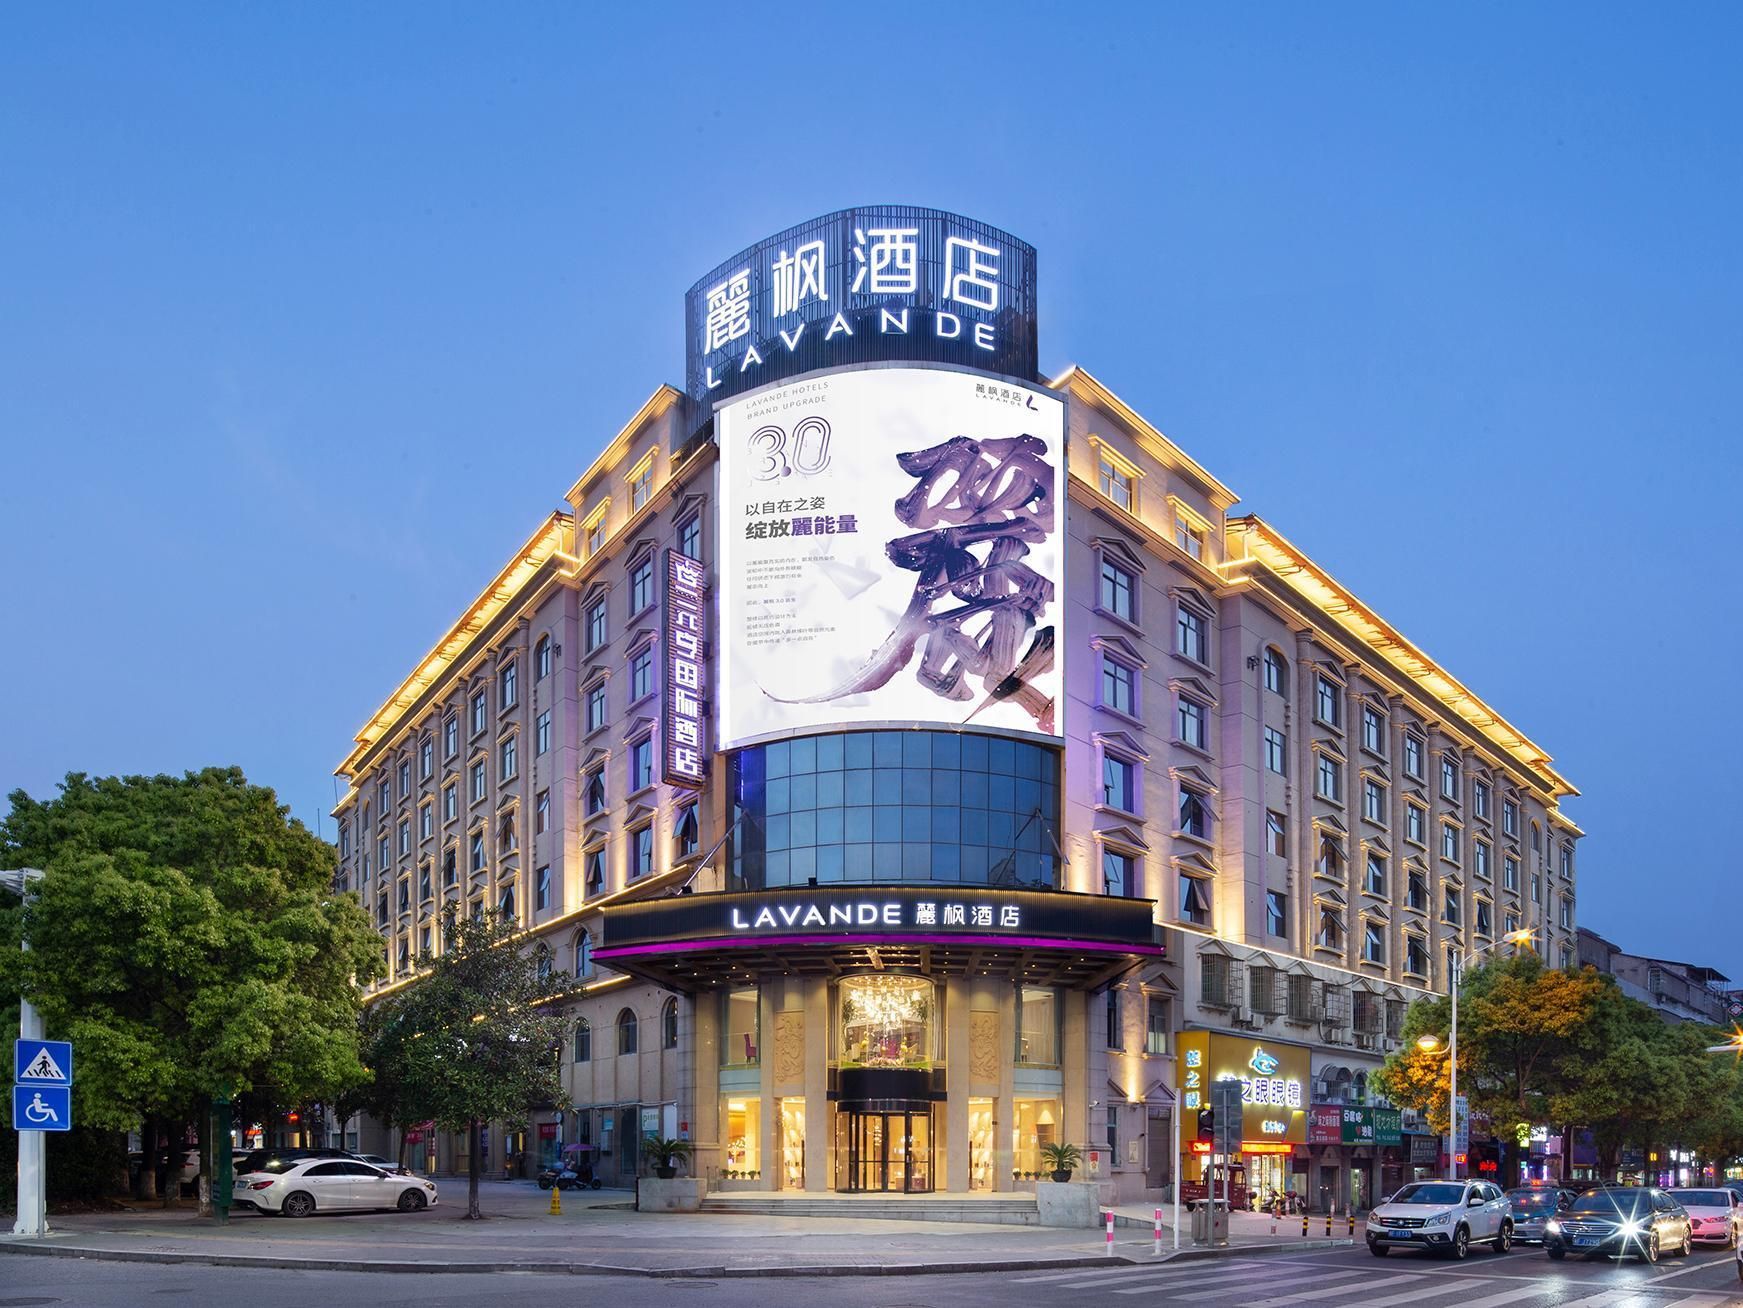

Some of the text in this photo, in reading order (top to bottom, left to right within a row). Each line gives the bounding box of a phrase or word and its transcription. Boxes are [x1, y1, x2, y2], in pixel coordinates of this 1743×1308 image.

[703, 228, 1000, 355] 麗枫酒店
[706, 308, 996, 389] LAVANDE
[746, 381, 829, 409] LAVANDE HOTELS
[747, 395, 827, 420] BRAND UPGRADE
[745, 496, 825, 517] 以自在之姿
[745, 514, 858, 540] 绽放麗能量
[732, 903, 1020, 929] LAVANDE 麗枫酒店
[1218, 1073, 1301, 1107] 之眼眼镜
